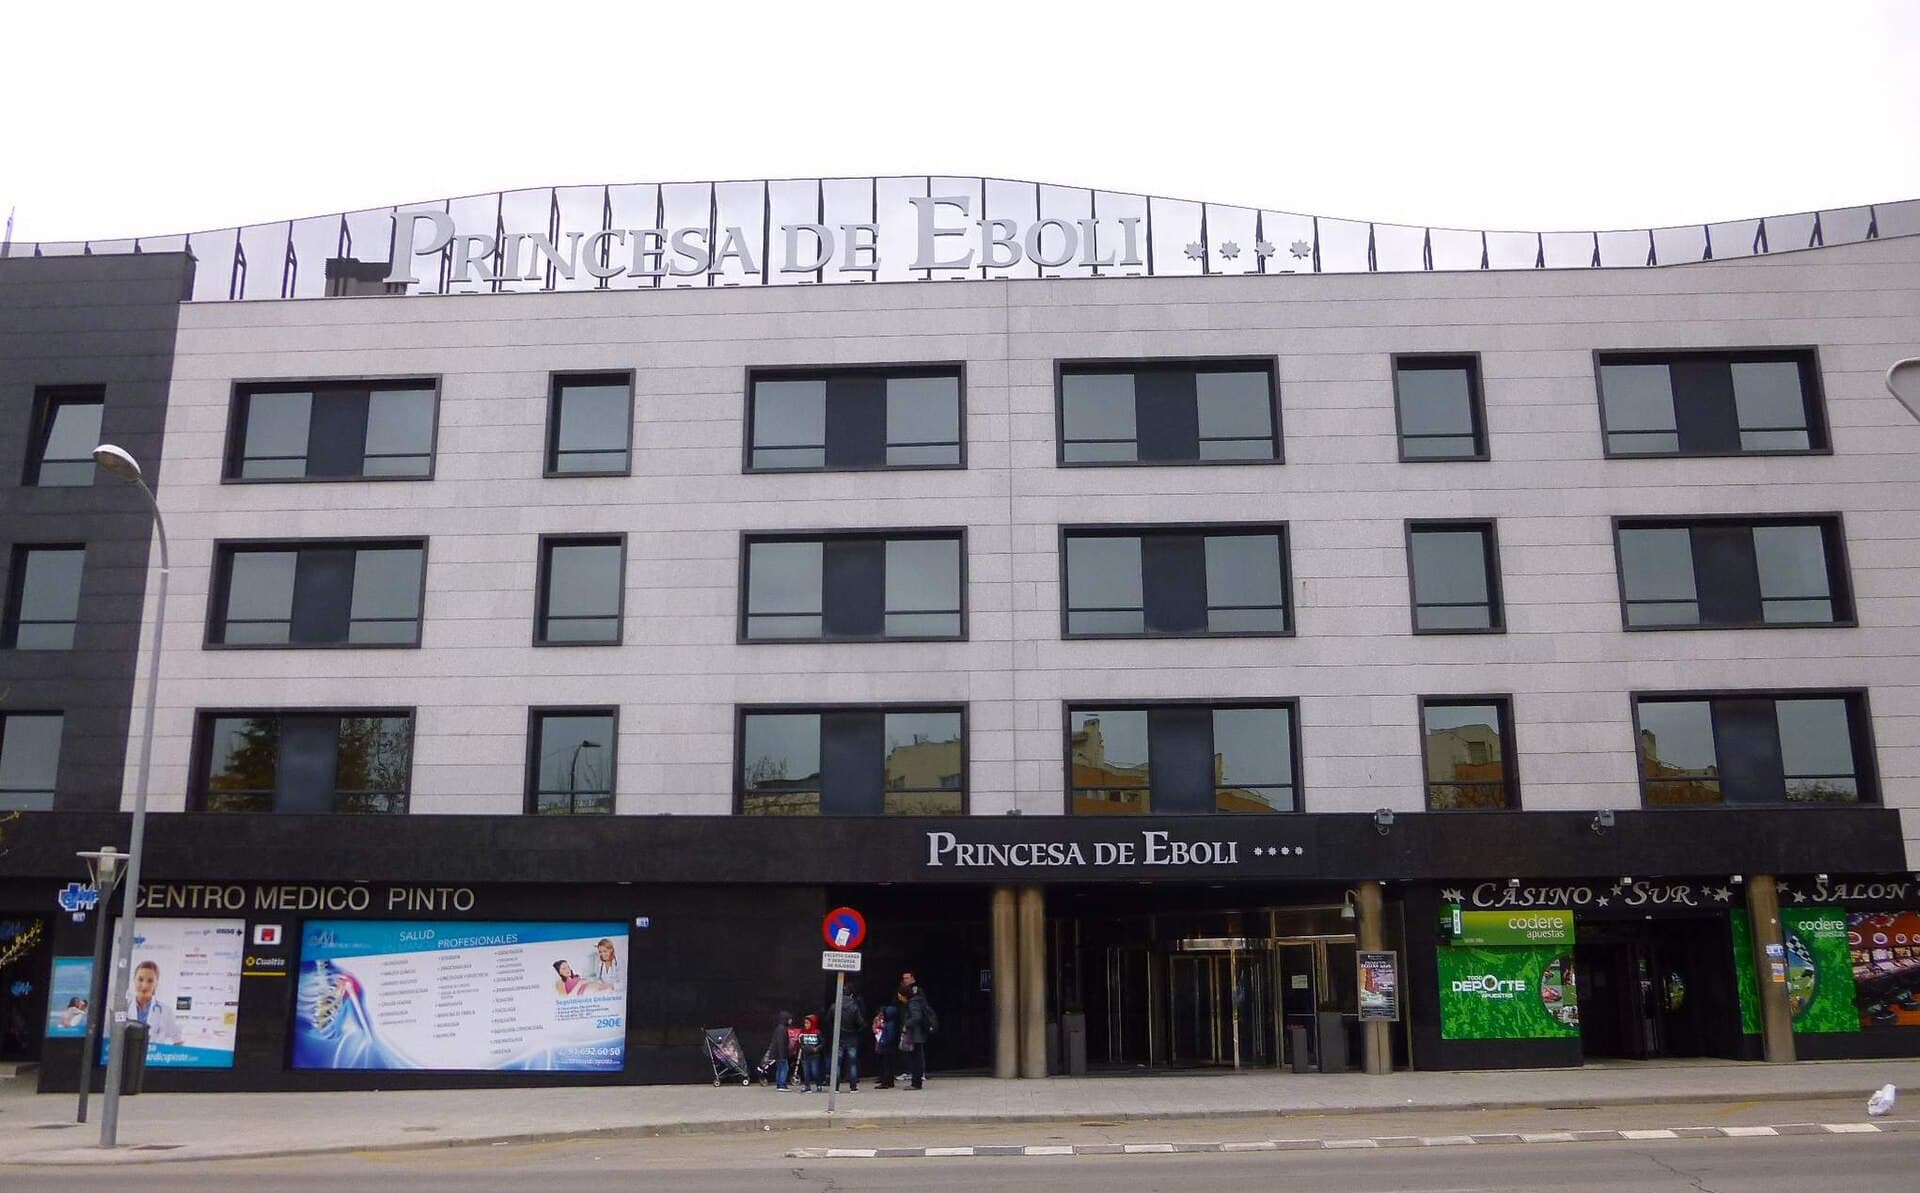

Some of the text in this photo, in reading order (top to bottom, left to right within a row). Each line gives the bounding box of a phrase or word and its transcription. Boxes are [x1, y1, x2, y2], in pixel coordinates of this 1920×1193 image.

[384, 196, 1144, 284] PRINCESA DE EBOLI
[926, 831, 1238, 866] PRINCESA DE EBOLI
[254, 886, 370, 911] MEDICO
[388, 887, 475, 911] PINTO
[1472, 881, 1698, 908] CASINO SUR
[1812, 880, 1910, 902] SALON
[1508, 913, 1564, 929] codere
[1798, 917, 1845, 931] codere
[400, 929, 436, 942] SALUD
[438, 934, 518, 948] PROFESIONALES
[1526, 929, 1565, 940] apuestas
[596, 1018, 622, 1029] 290€
